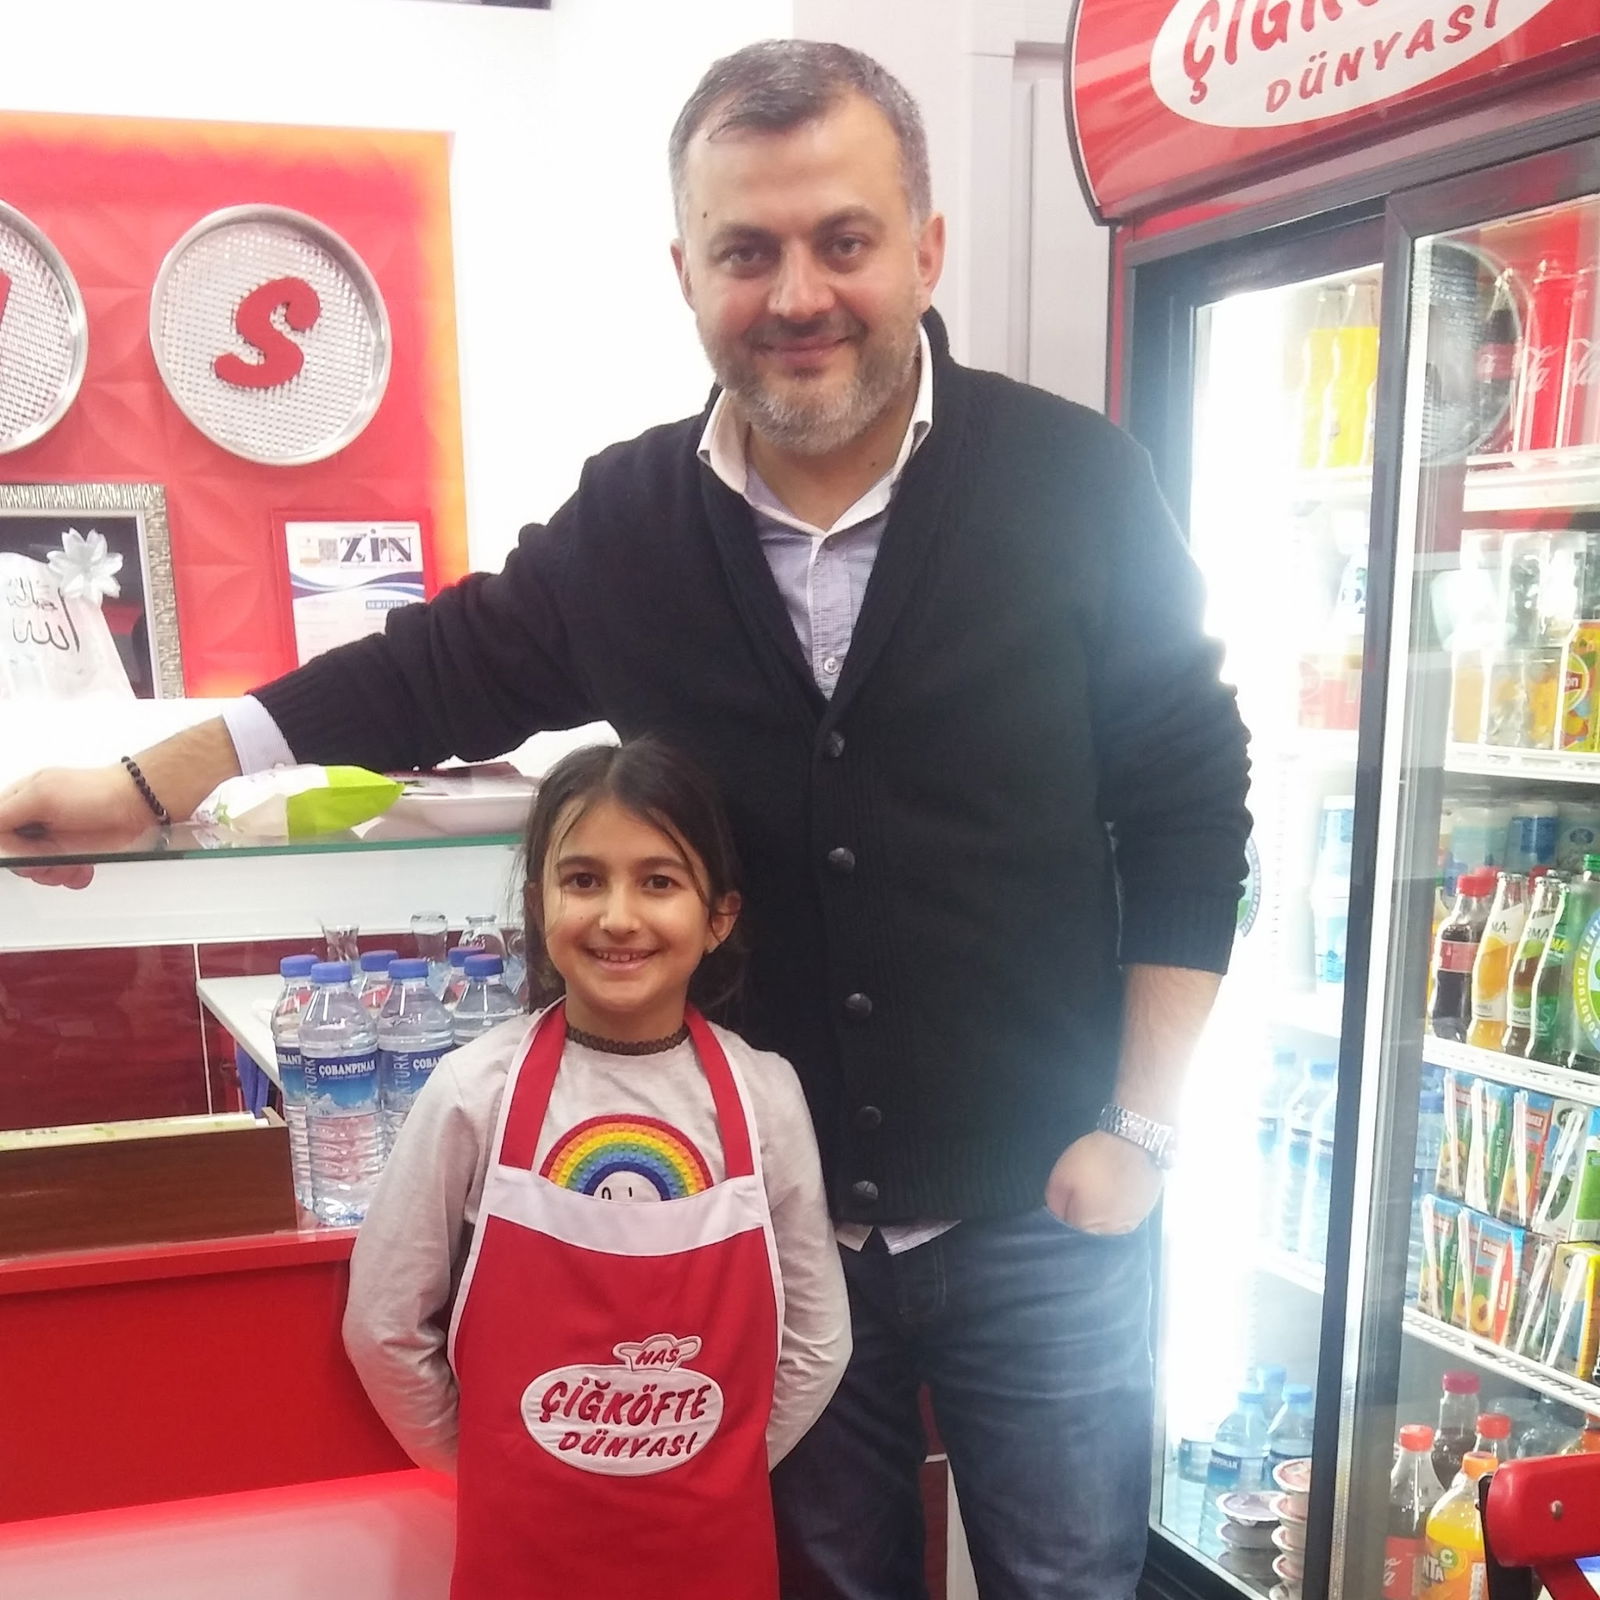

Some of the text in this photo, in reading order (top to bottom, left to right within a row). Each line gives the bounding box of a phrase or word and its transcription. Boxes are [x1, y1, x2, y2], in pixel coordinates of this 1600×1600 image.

[1266, 0, 1498, 113] DÜNYASI
[213, 276, 321, 389] S
[635, 1348, 680, 1365] HAS
[539, 1376, 712, 1427] ÇİĞKÖFTE
[558, 1428, 698, 1459] DÜNYASI
